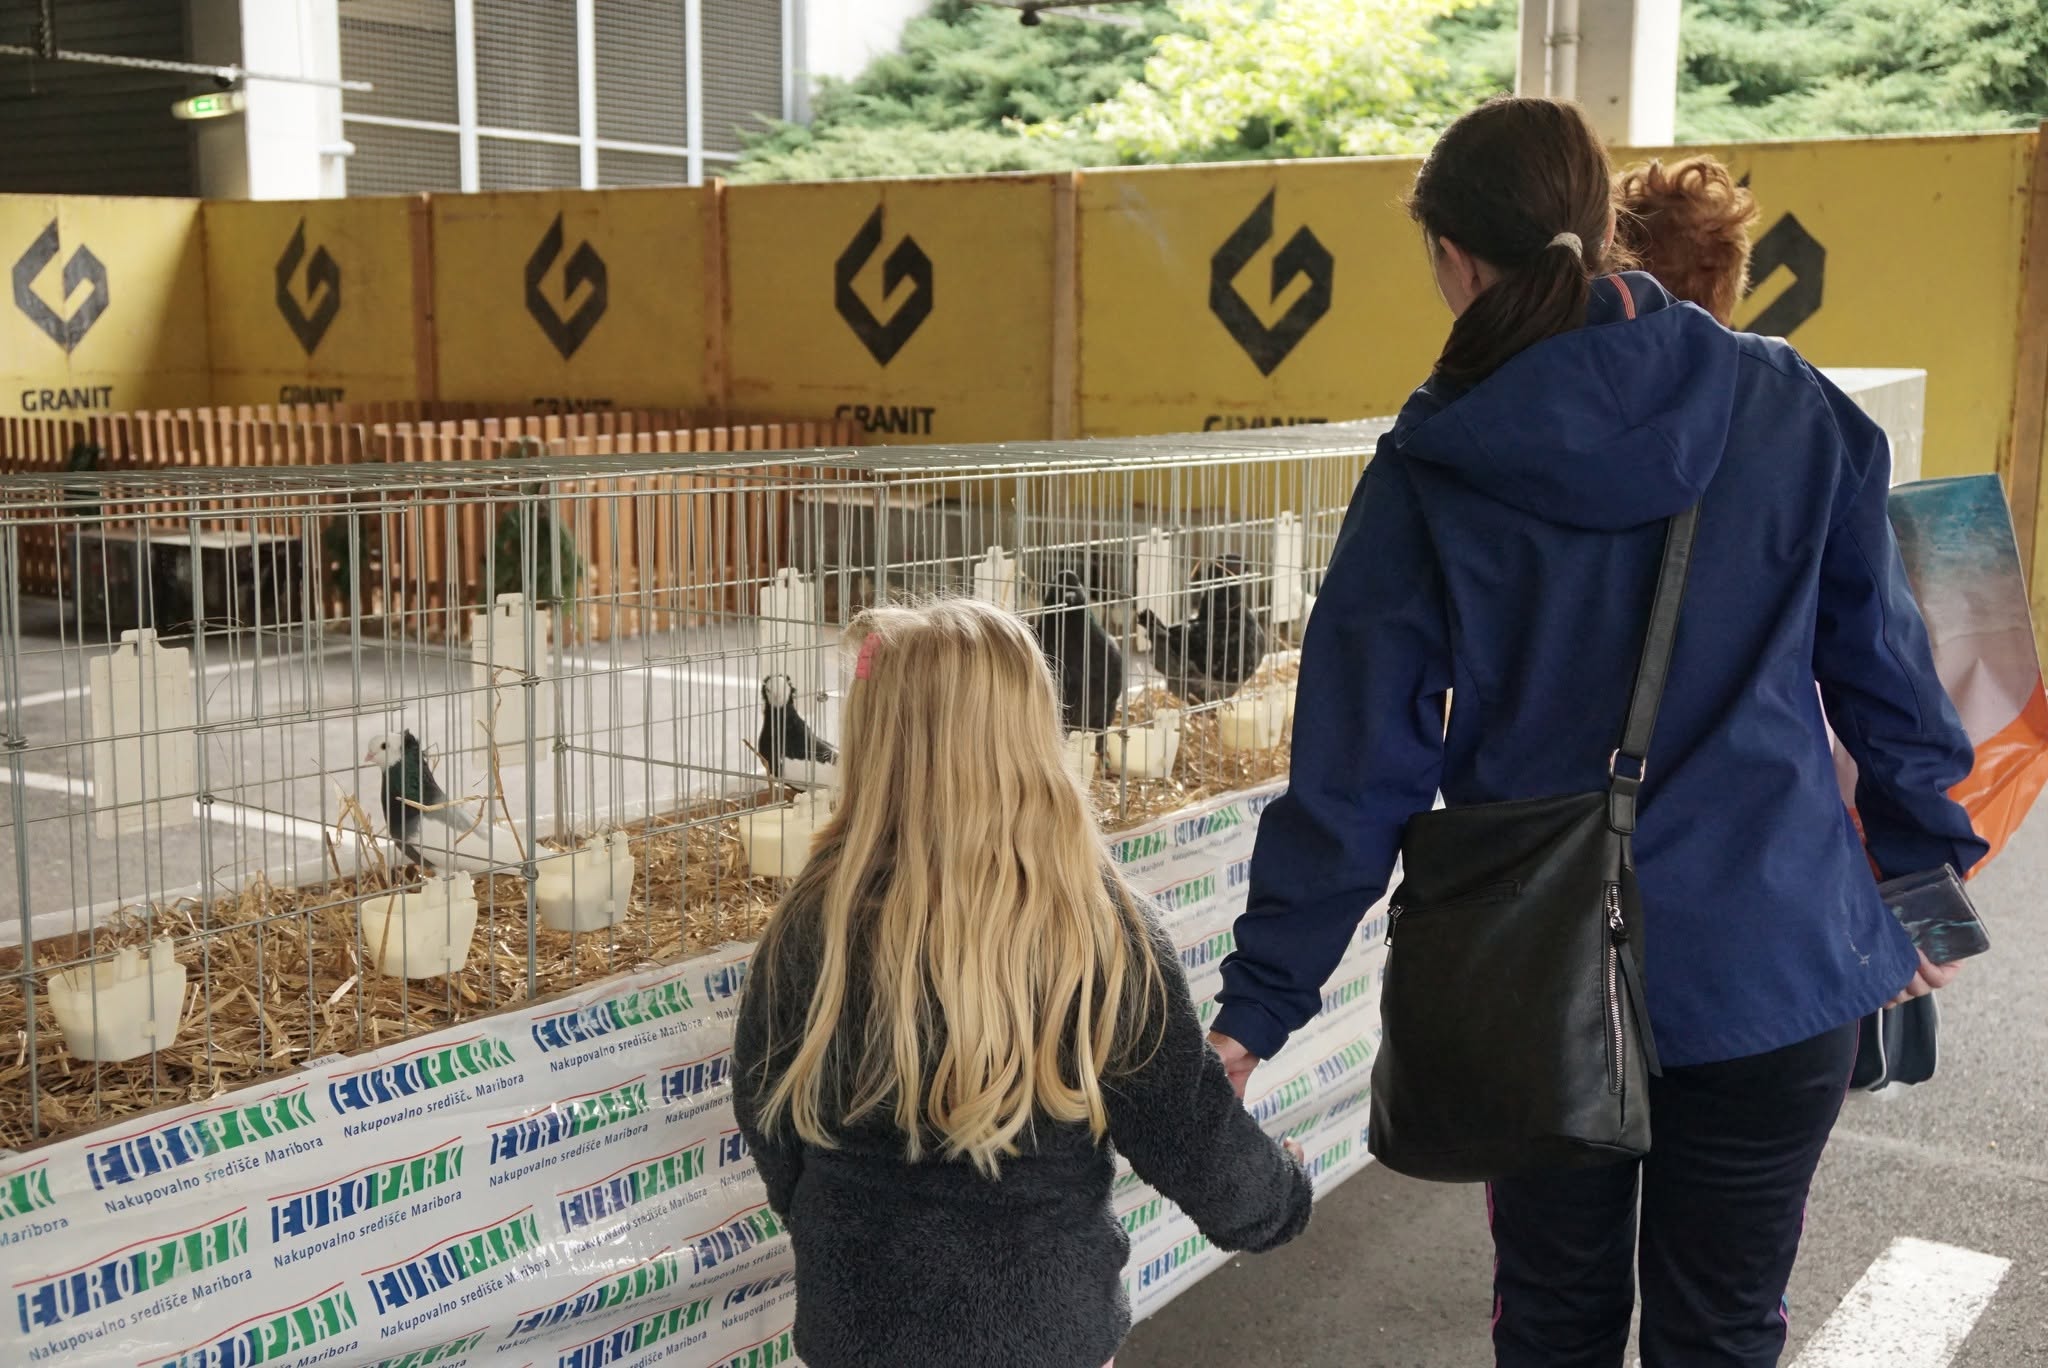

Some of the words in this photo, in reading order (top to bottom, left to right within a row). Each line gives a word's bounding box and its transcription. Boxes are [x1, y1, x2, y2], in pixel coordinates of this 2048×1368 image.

[22, 385, 113, 412] GRANIT
[532, 979, 694, 1053] EUROPARK
[550, 1045, 615, 1073] Nakupovalno
[618, 1031, 657, 1052] središče
[660, 1017, 702, 1039] Maribora
[328, 1037, 516, 1116] EUROPARK
[343, 1106, 423, 1138] Nakupovalno
[475, 1073, 525, 1098] Maribora
[665, 1095, 723, 1125] Nakupovalno
[86, 1091, 316, 1190] EUROPARK
[489, 1082, 649, 1165] EUROPARK
[489, 1156, 557, 1188] Nakupovalno
[560, 1139, 601, 1163] središče
[604, 1124, 648, 1146] Maribora
[105, 1176, 200, 1214] Nakupovalno
[205, 1156, 260, 1184] središče
[264, 1136, 324, 1165] Maribora
[271, 1145, 464, 1243] EUROPARK
[559, 1146, 705, 1234] EUROPARK
[669, 1188, 708, 1212] Maribora
[274, 1230, 356, 1269] Nakupovalno
[359, 1210, 407, 1237] središče
[411, 1190, 462, 1217] Maribora
[368, 1213, 541, 1315] EUROPARK
[17, 1216, 248, 1334] EUROPARK
[380, 1300, 457, 1339] Nakupovalno
[460, 1279, 504, 1306] središče
[505, 1253, 678, 1339] EUROPARK
[29, 1317, 126, 1362] Nakupovalno
[131, 1292, 188, 1325] središče
[192, 1268, 253, 1301] Maribora
[666, 1330, 707, 1357] Maribora
[721, 1297, 776, 1330] Nakupovalno
[297, 1340, 358, 1368] Maribora
